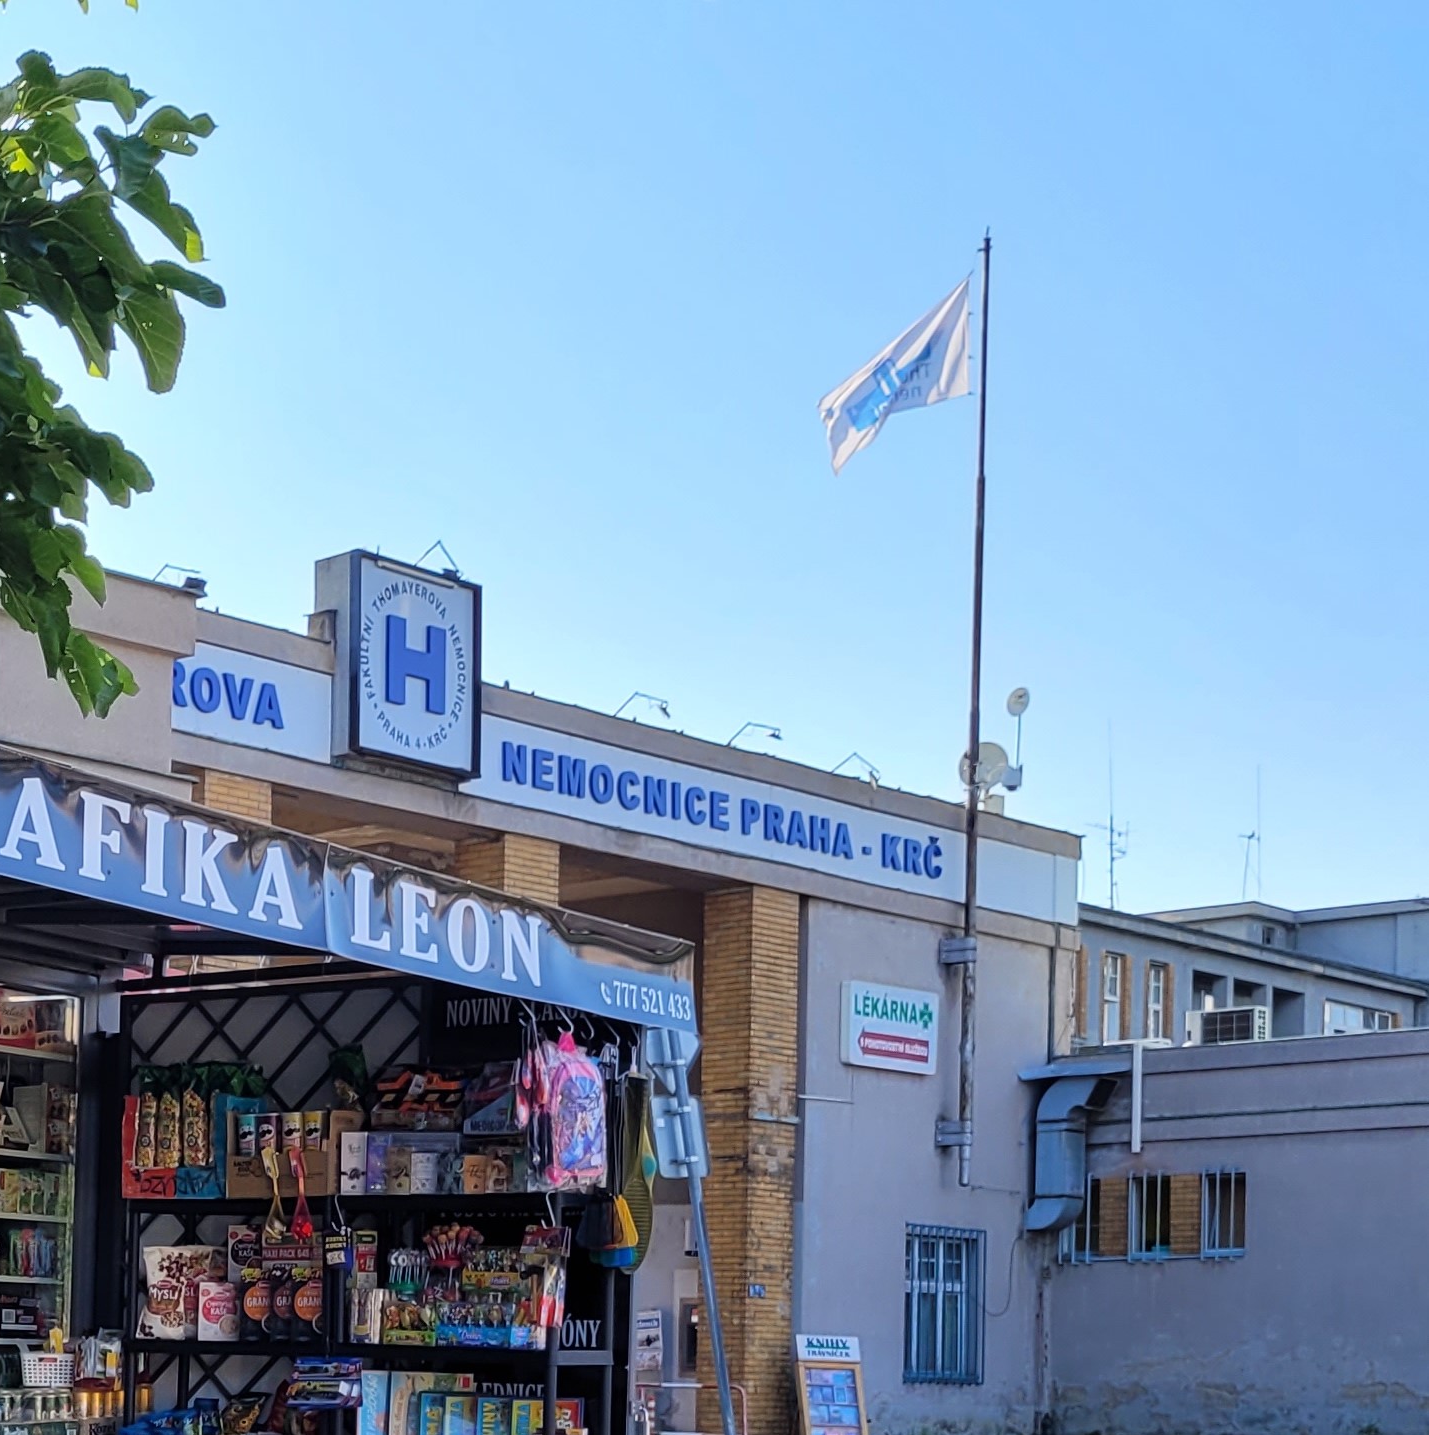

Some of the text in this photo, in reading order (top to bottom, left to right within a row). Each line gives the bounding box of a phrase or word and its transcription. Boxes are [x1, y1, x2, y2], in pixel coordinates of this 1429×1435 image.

[371, 580, 447, 620] THOMAYEROVA
[385, 614, 447, 716] H
[447, 624, 467, 723] NEMOCNICE
[376, 710, 411, 749] PRAHA
[501, 741, 730, 832] NEMOCNICE
[741, 798, 854, 860] PRAHA
[881, 832, 943, 880] KRČ
[350, 866, 543, 988] LEON
[446, 997, 512, 1028] NOVINY
[613, 980, 691, 1021] 777 521 433
[854, 989, 918, 1025] LÉKÁRNA
[806, 1337, 849, 1349] KNIHY
